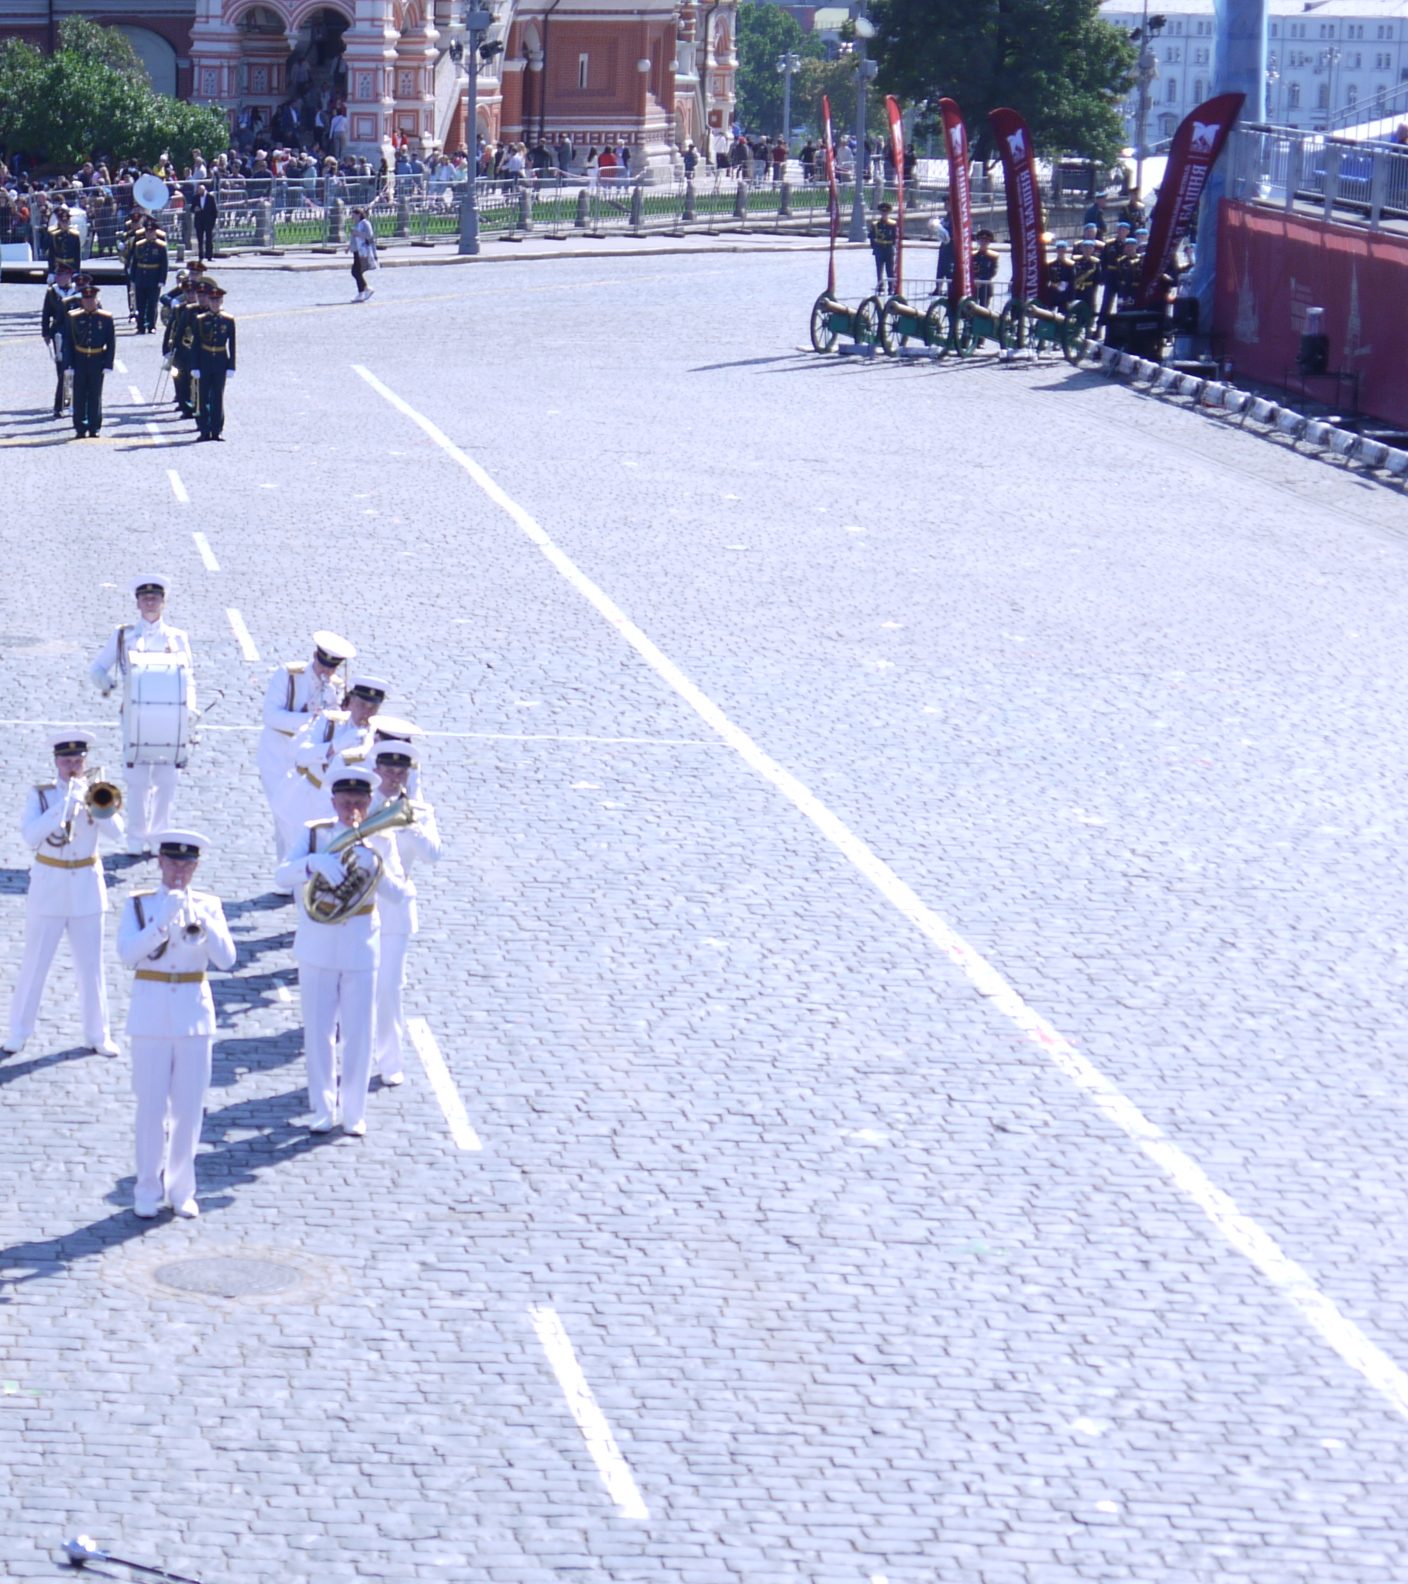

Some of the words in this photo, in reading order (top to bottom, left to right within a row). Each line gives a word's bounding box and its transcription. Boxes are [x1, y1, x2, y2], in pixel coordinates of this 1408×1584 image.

[1020, 169, 1034, 226] БАШНЯ
[1179, 164, 1208, 220] БАШНЯ
[1026, 229, 1038, 301] ПАССКАЯ
